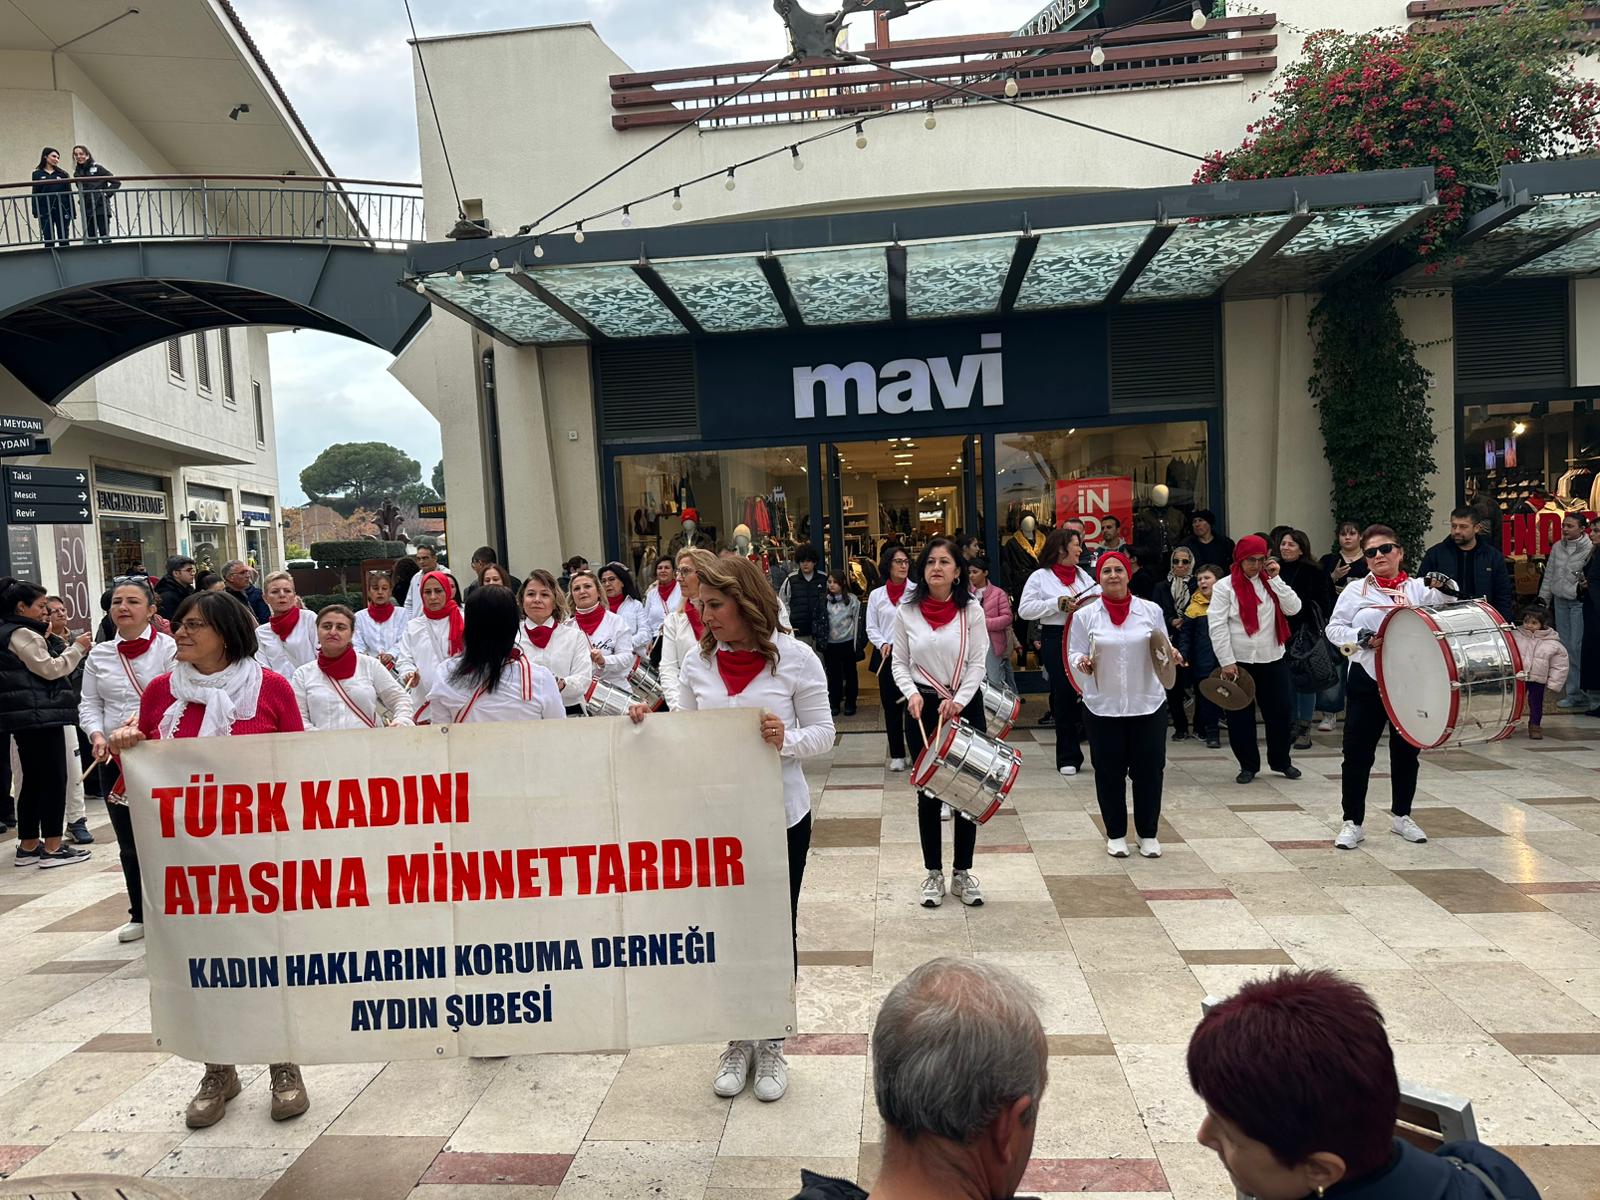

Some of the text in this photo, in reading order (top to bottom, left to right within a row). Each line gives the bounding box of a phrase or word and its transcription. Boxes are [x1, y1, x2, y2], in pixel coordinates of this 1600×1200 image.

[793, 332, 1004, 419] mavi
[3, 419, 42, 430] MEYDANI
[12, 471, 32, 480] Taksi
[14, 491, 37, 499] Mescit
[16, 509, 36, 517] Revir
[97, 490, 164, 514] ENGLISH HOME
[61, 537, 86, 575] 50
[65, 581, 89, 621] 50
[151, 772, 470, 838] TÜRK KADINI
[164, 836, 745, 915] ATASINA MİNNETTARDIR
[188, 925, 716, 989] KADIN HAKLARINI KORUMA DERNEĞI
[350, 983, 553, 1033] AYDIN ŞUBESİ
